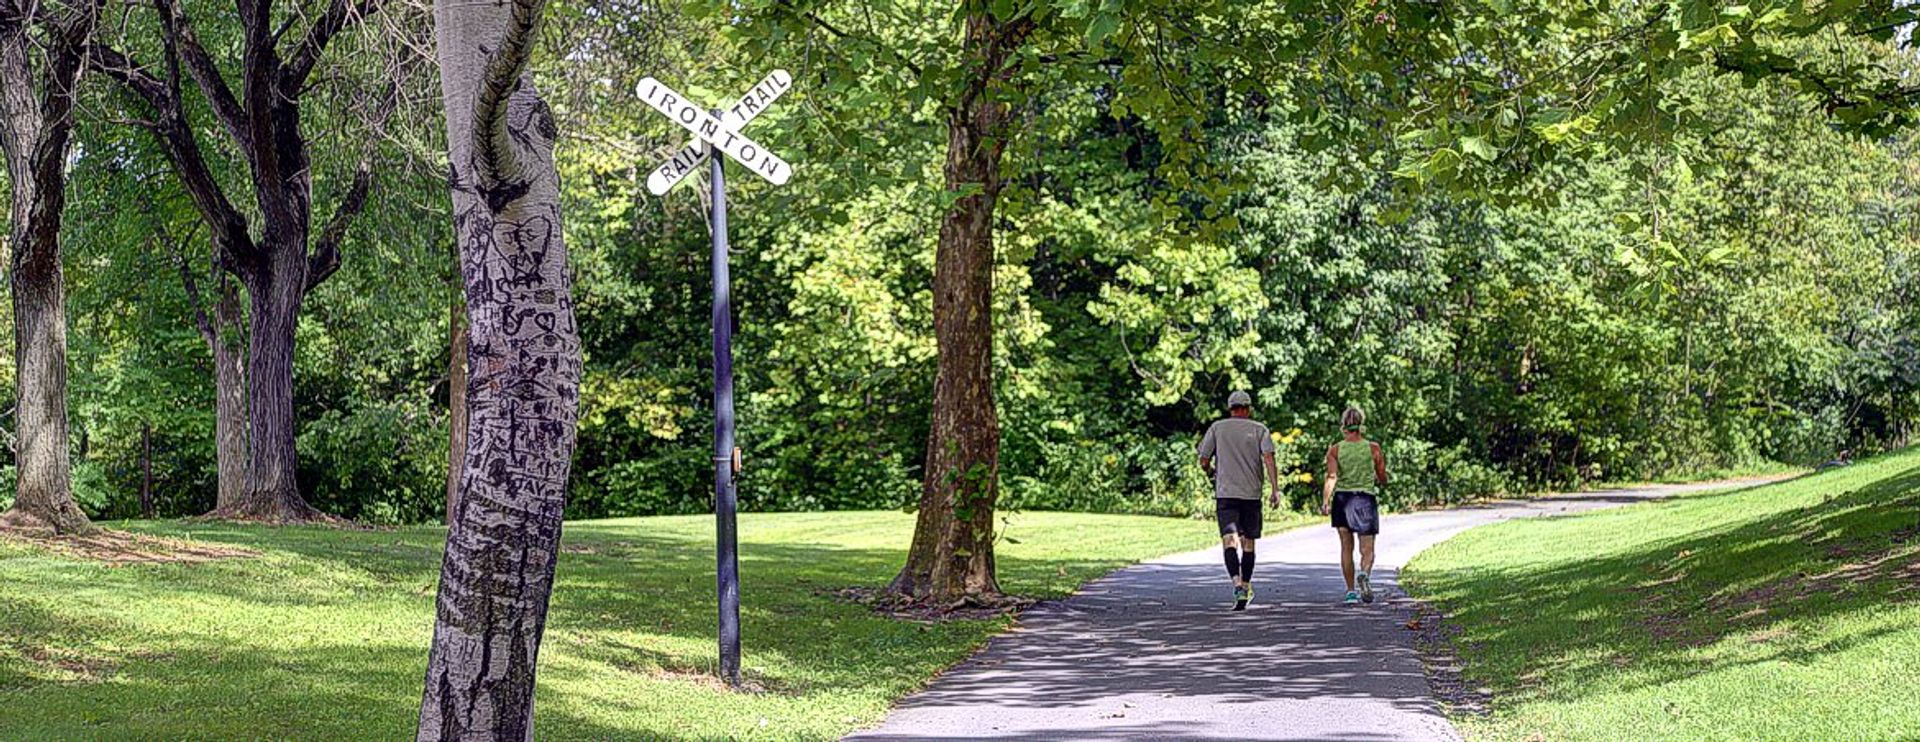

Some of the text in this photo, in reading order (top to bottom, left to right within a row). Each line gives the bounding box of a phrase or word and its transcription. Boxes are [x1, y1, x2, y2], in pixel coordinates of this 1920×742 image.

[648, 85, 779, 176] IRONTON
[660, 74, 788, 183] RAIL TRAIL
